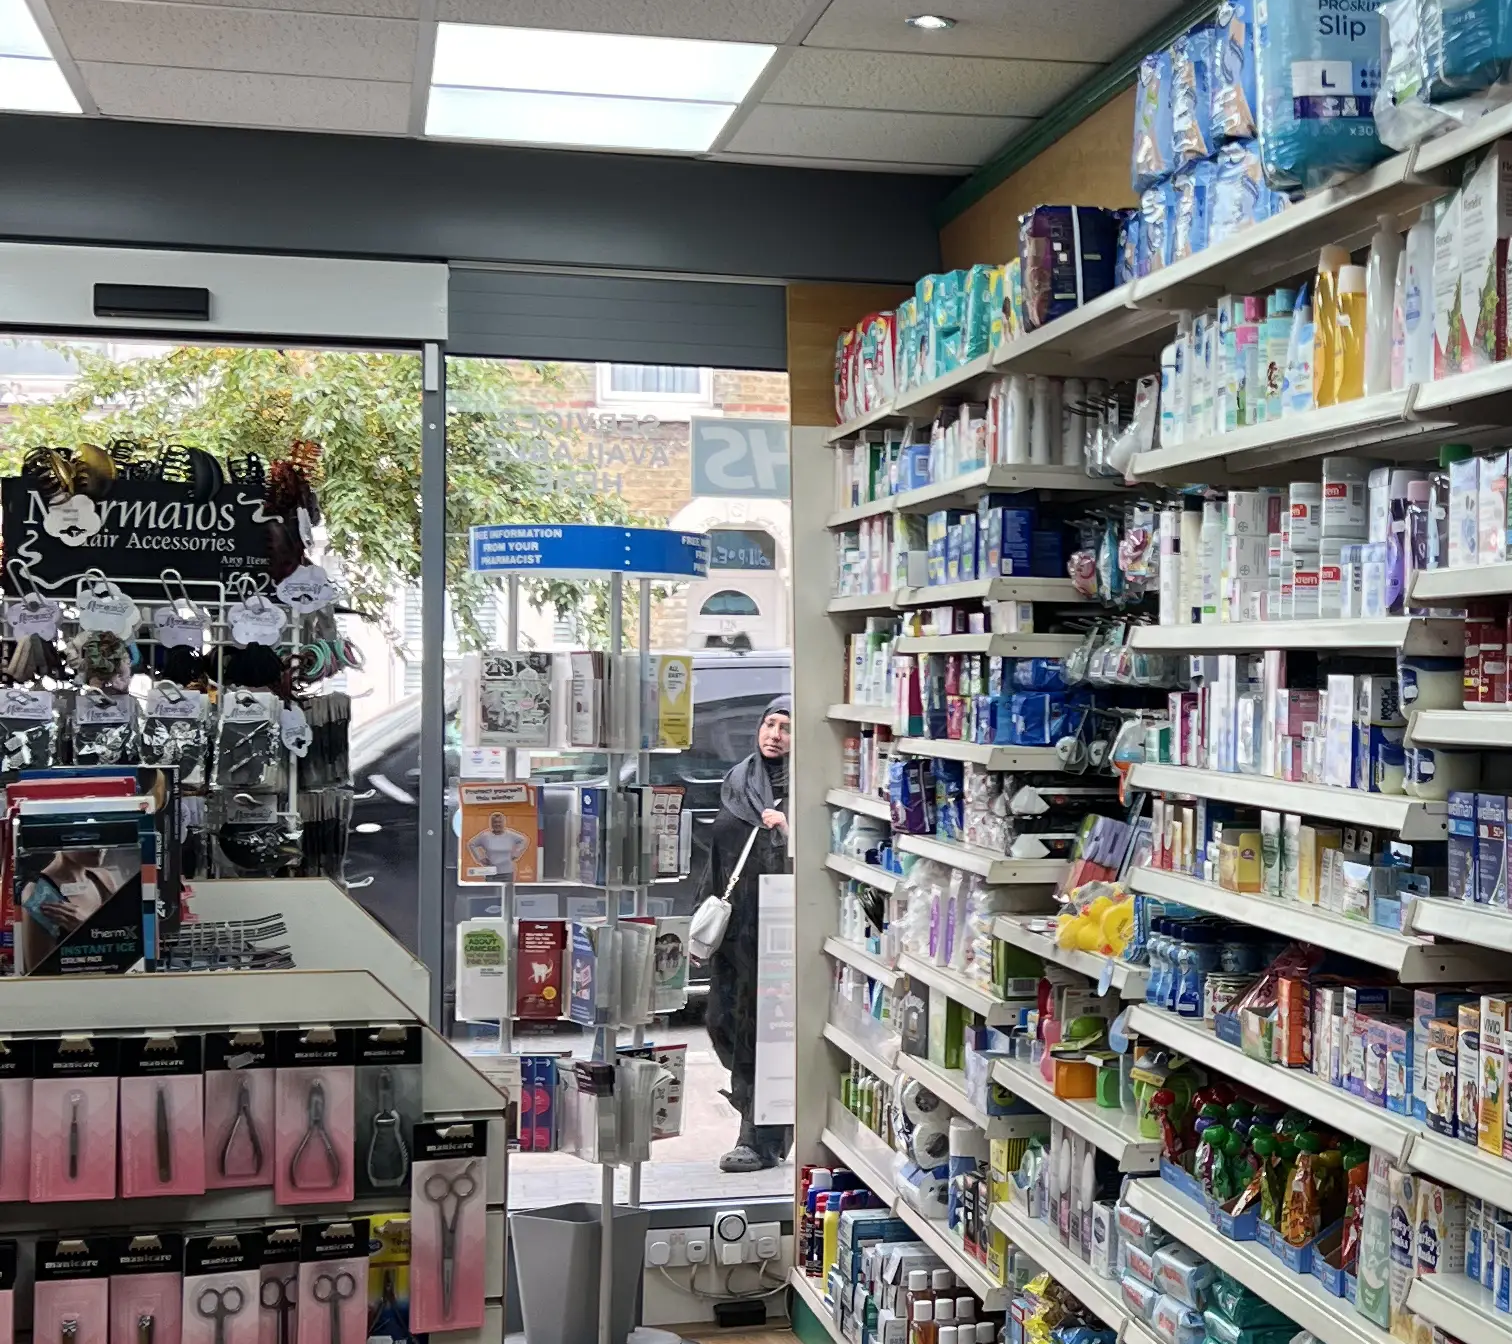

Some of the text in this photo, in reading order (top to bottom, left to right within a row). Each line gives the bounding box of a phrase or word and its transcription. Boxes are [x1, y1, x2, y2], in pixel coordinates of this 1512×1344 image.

[1318, 15, 1366, 41] Slip
[1321, 69, 1336, 88] L
[1349, 125, 1374, 137] x30
[492, 528, 563, 540] INFORMATION
[125, 533, 236, 552] Accessories
[483, 540, 539, 552] FROM YOUR
[220, 555, 243, 567] Any
[481, 554, 542, 566] PHARMACIST
[465, 787, 523, 797] Protect yourself
[468, 937, 498, 946] ABOUT
[61, 942, 136, 956] INSTANT ICE
[294, 1051, 338, 1059] manicare
[363, 1048, 406, 1057] manicare
[53, 1060, 100, 1069] manicare
[139, 1059, 184, 1067] manicare
[426, 1142, 474, 1152] manicare
[44, 1259, 99, 1269] manicare
[119, 1254, 172, 1264] manicare
[201, 1256, 244, 1266] manicare
